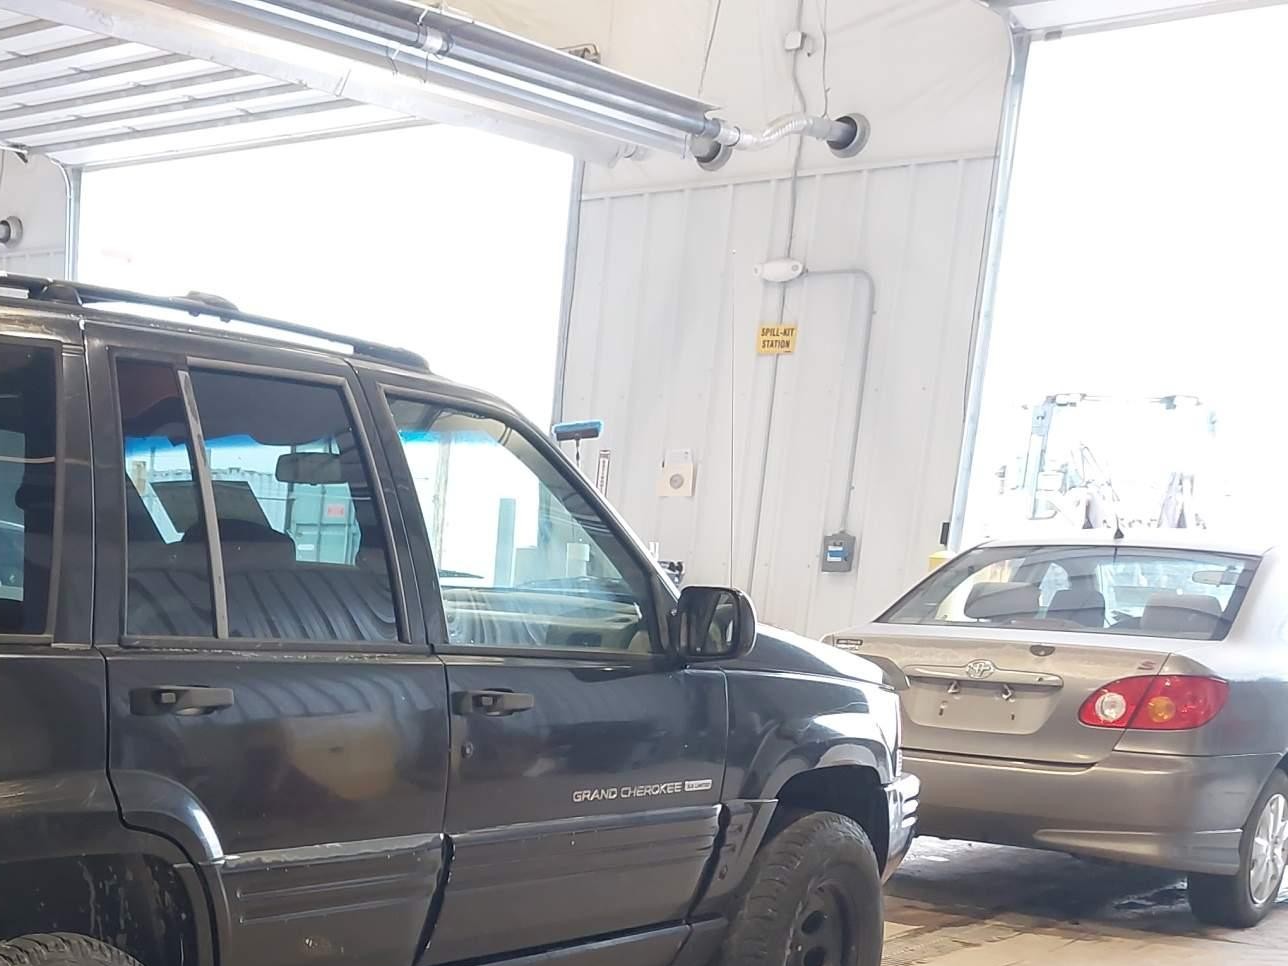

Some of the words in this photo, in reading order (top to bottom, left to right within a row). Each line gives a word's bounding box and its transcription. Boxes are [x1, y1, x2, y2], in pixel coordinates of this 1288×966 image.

[761, 327, 795, 336] SPILL-KIT
[761, 339, 790, 349] STATION
[572, 788, 617, 802] GRAND
[620, 782, 683, 798] CHEROKEE
